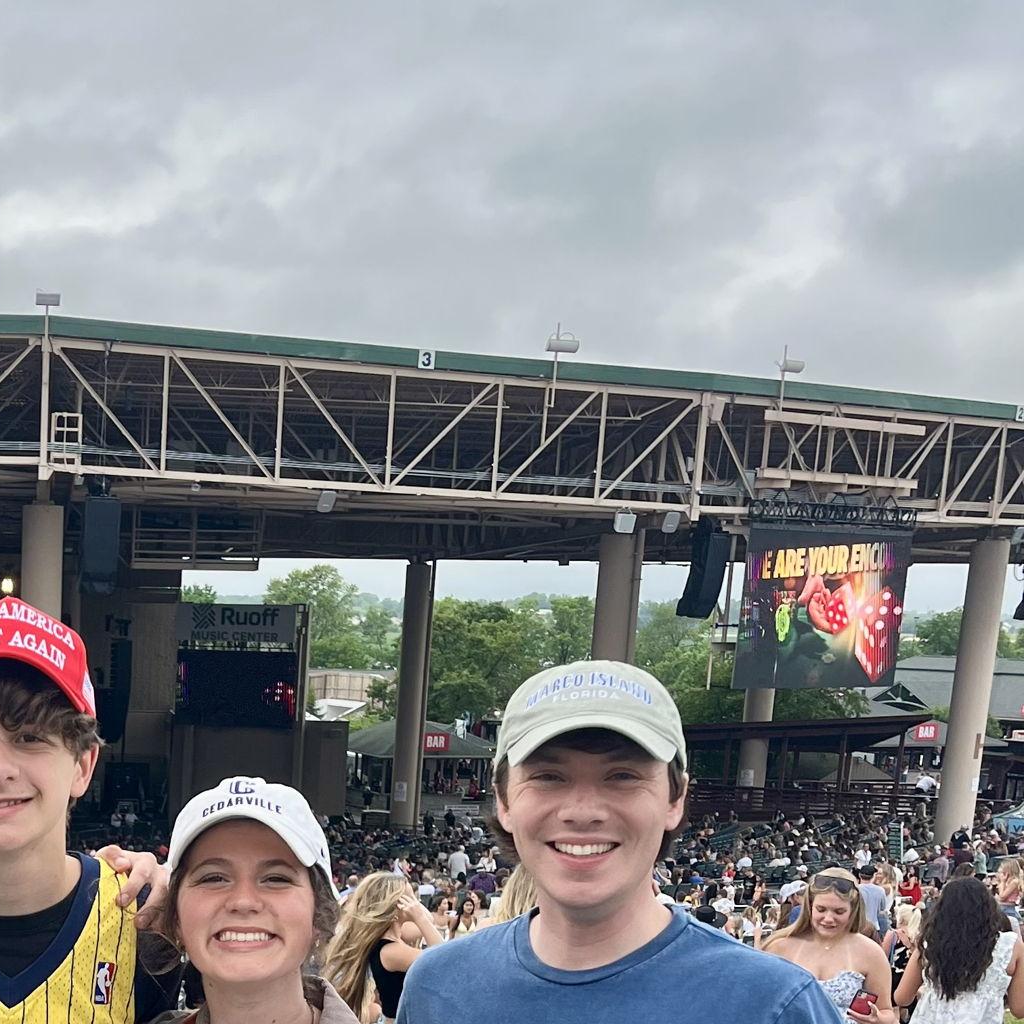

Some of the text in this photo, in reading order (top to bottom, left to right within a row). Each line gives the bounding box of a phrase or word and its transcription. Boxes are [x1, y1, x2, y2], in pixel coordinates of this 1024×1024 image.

[421, 351, 432, 367] 3
[773, 546, 807, 578] ARE
[808, 544, 849, 576] YOUR
[221, 607, 280, 626] Ruoff
[191, 630, 279, 642] MUSIC CENTER
[8, 631, 67, 671] AGAIN
[526, 671, 653, 711] MARCO ISLAND
[552, 689, 621, 703] FLORIDA
[918, 725, 935, 738] BAR
[426, 735, 445, 748] BAR
[202, 796, 282, 818] CEDARVILLE
